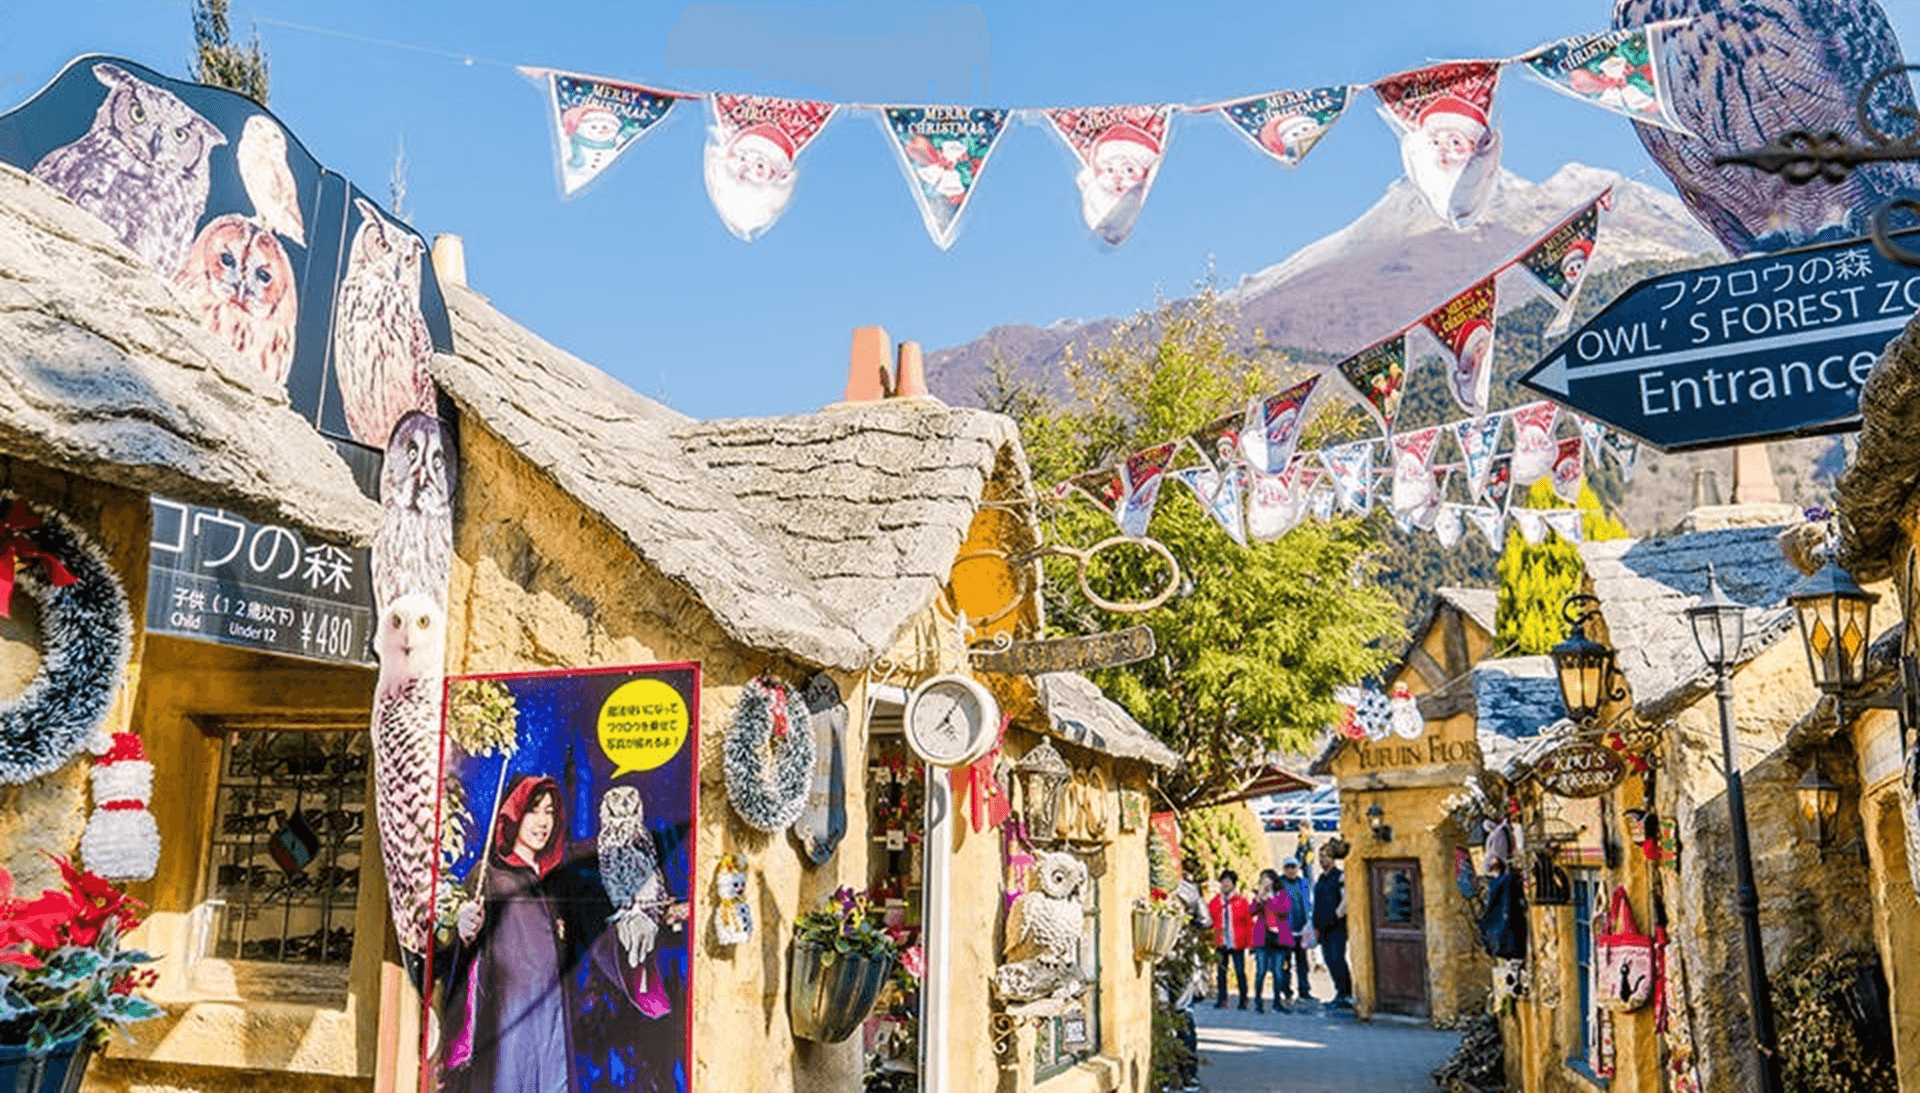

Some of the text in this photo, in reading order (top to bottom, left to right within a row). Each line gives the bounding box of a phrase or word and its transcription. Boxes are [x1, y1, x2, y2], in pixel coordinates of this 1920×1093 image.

[908, 121, 986, 135] CHRISTMAS
[924, 105, 973, 120] MERRY
[1656, 248, 1873, 310] フクロウの森
[1721, 285, 1865, 339] FOREST
[1638, 350, 1877, 416] Entrance
[171, 611, 277, 643] Child Under 12
[1353, 740, 1421, 769] YUFUIN
